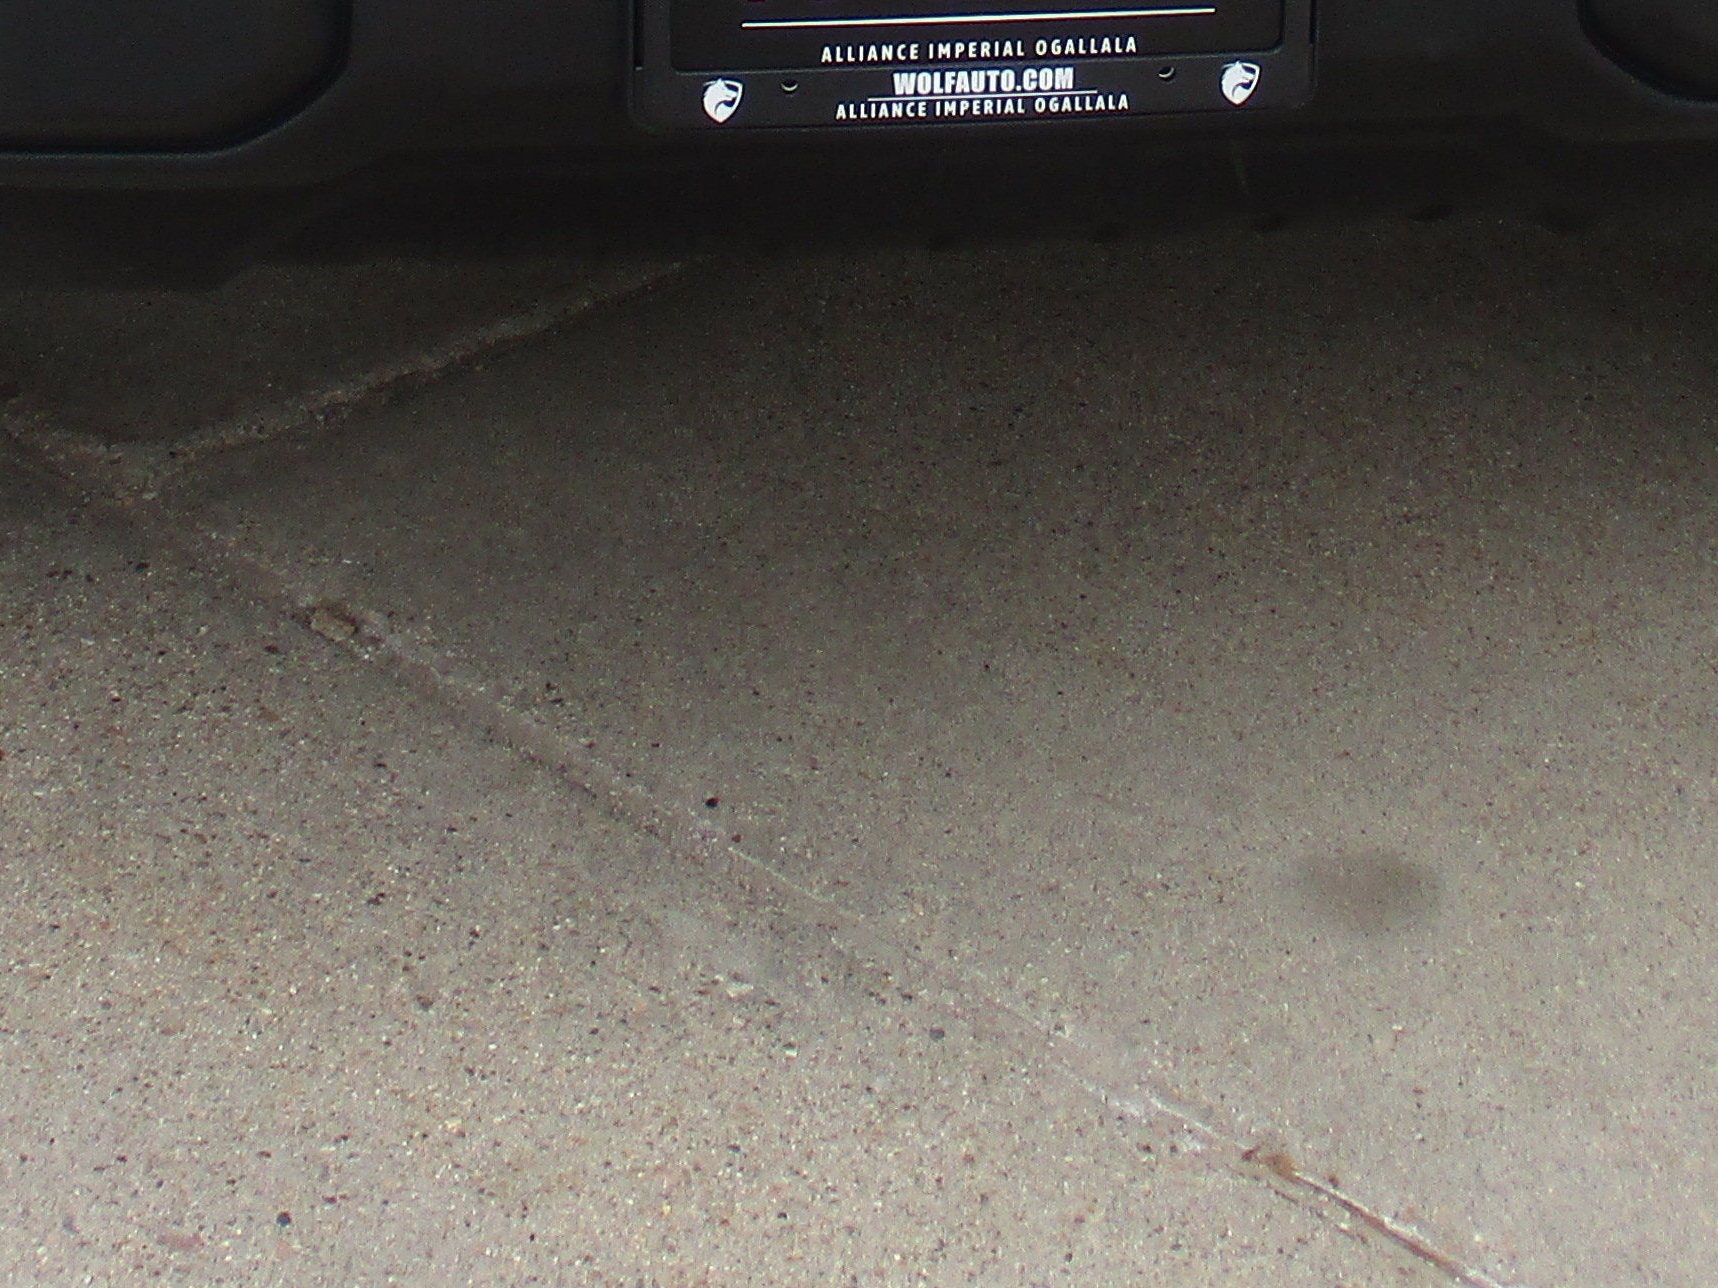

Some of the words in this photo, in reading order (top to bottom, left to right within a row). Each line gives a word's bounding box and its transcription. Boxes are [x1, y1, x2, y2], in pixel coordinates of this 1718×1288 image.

[821, 43, 920, 63] ALLIANCE
[928, 39, 1025, 60] IMPERIAL
[1035, 36, 1137, 56] OGALLALA
[892, 66, 1074, 96] WOLFAUTO.COM
[835, 101, 927, 120] ALLIANCE
[935, 96, 1025, 117] IMPERIAL
[1034, 93, 1129, 114] OGALLALA
